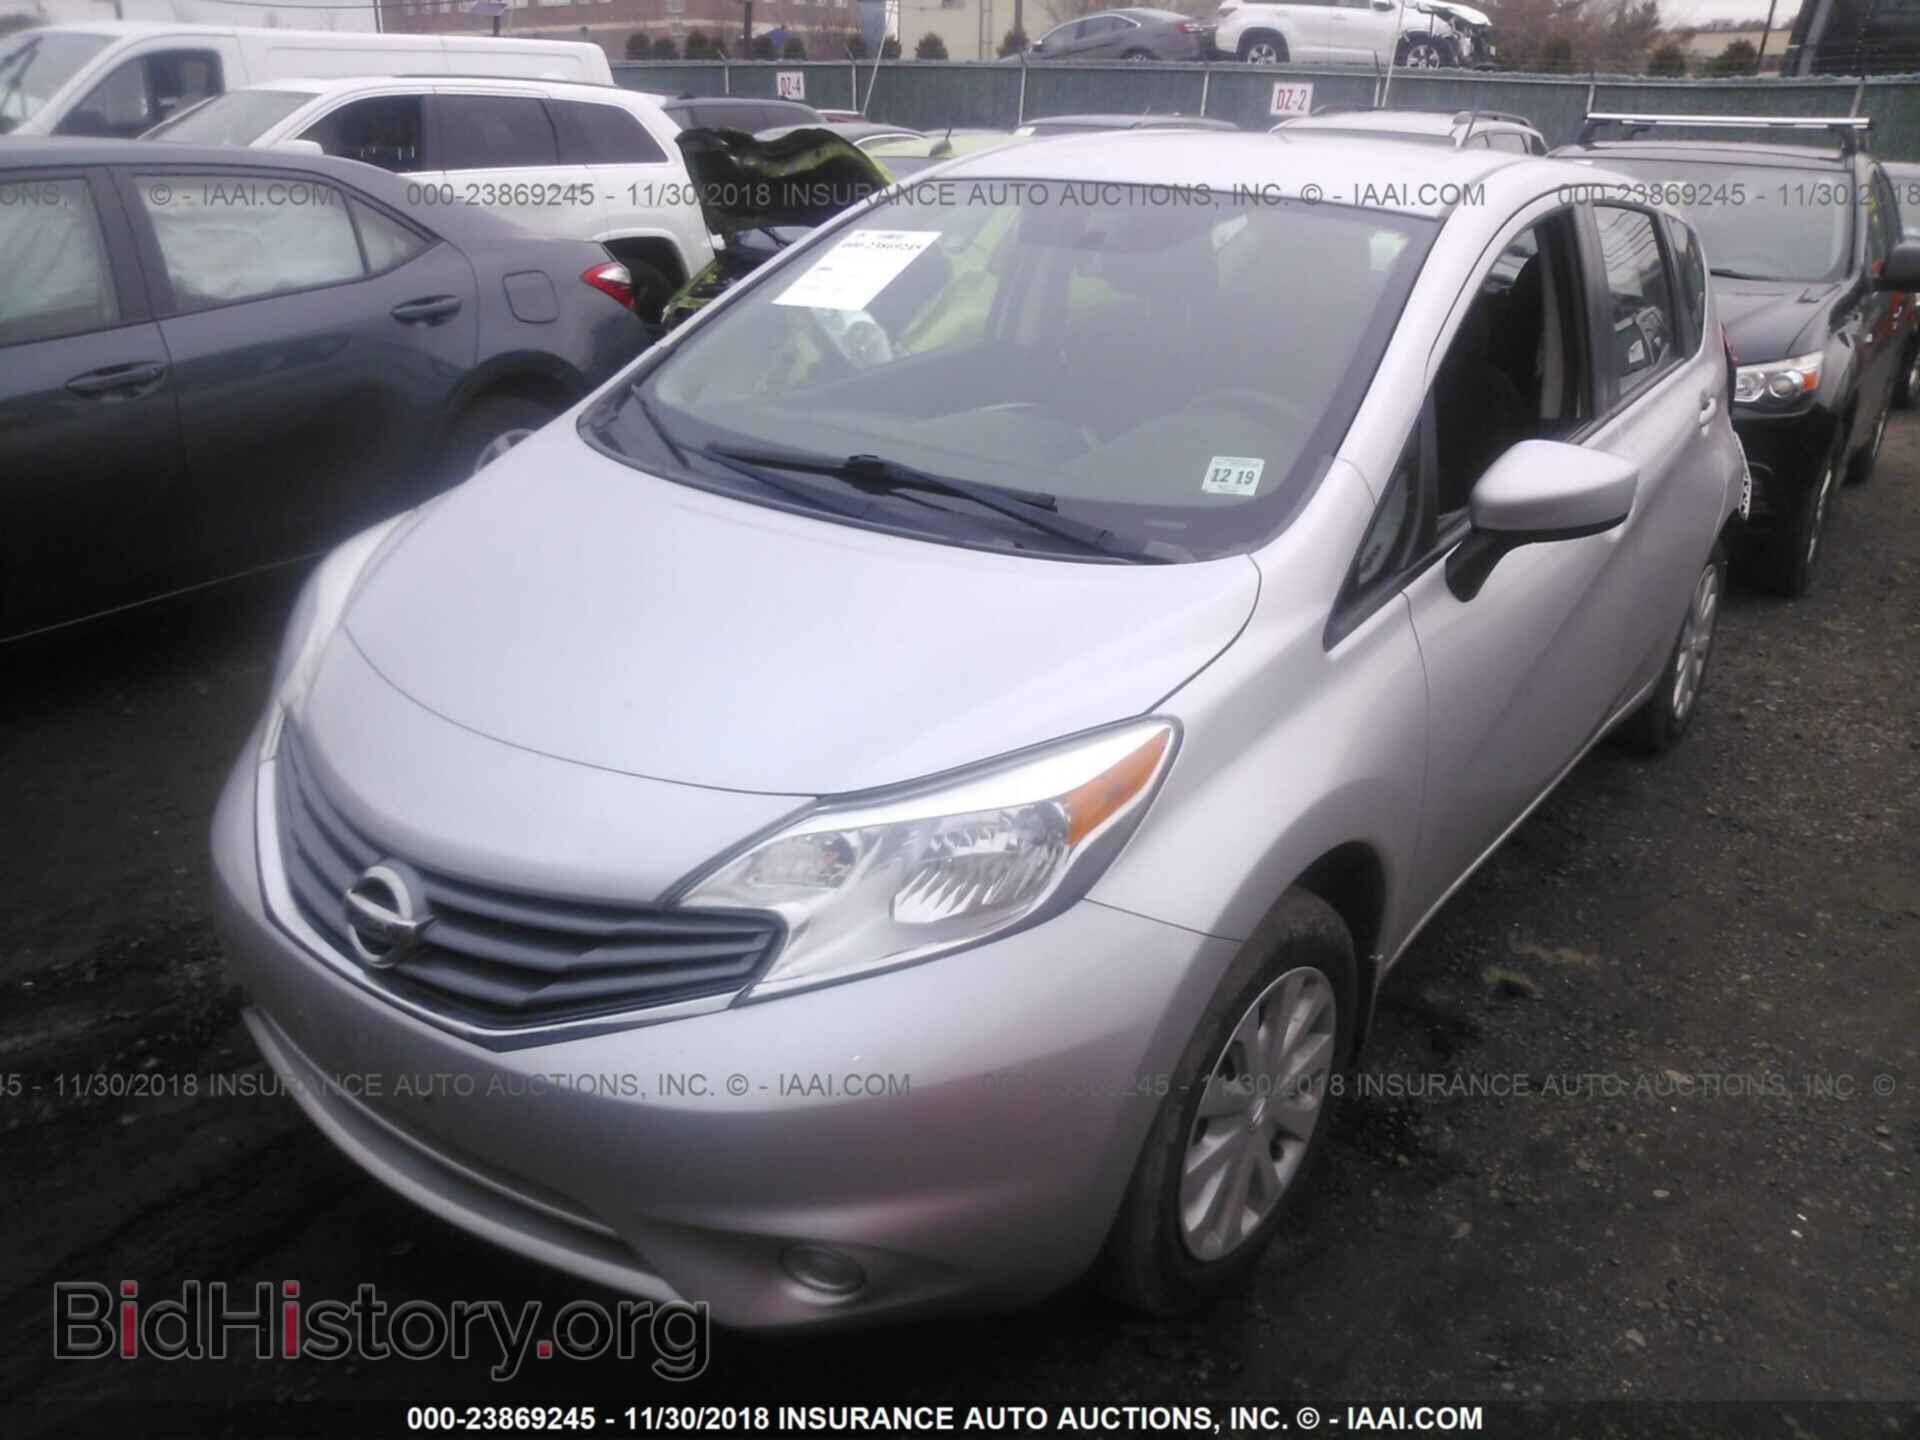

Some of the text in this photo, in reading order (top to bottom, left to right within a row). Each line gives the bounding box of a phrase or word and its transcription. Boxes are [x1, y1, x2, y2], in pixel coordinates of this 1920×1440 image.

[1276, 89, 1308, 111] DZ-2
[1211, 468, 1255, 485] 12 19
